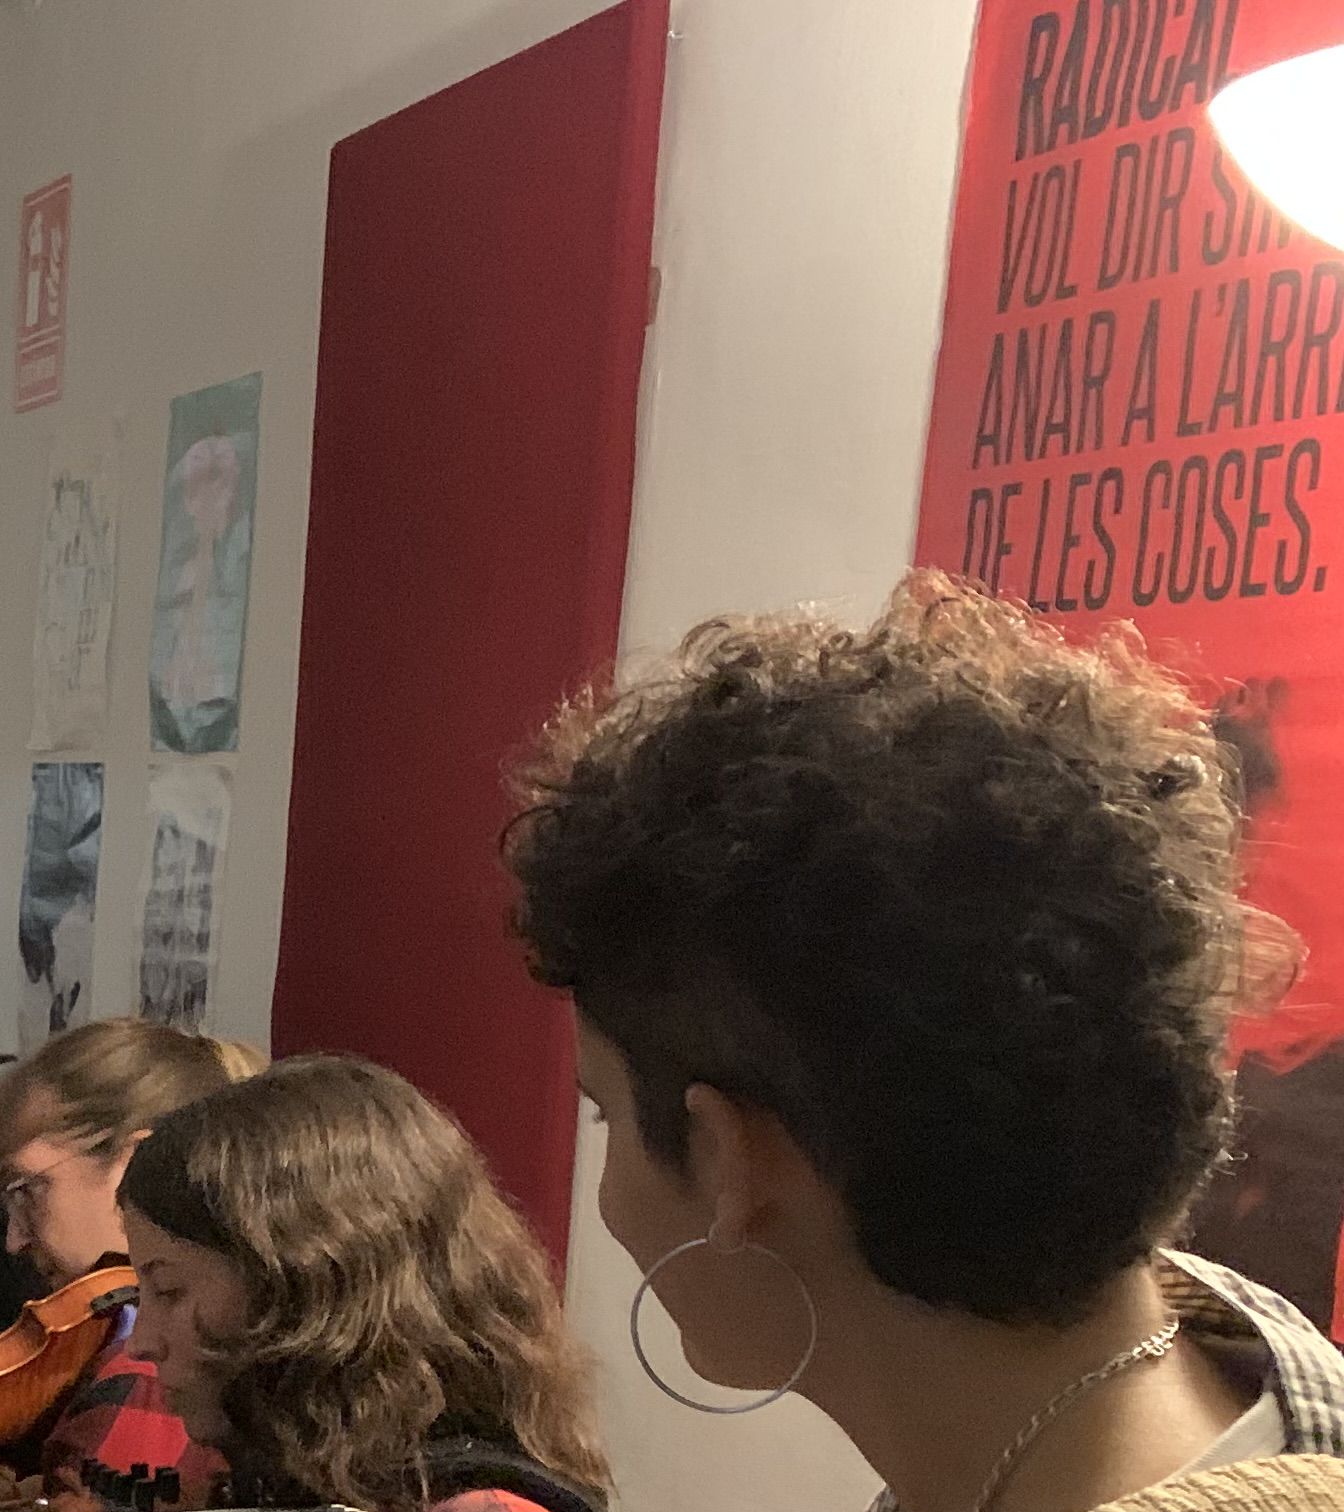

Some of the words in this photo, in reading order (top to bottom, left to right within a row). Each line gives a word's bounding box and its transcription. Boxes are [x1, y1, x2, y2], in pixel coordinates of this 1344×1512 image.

[1015, 0, 1242, 162] RADICAL
[997, 158, 1082, 315] VOL
[1097, 126, 1195, 291] DIR
[972, 310, 1115, 470] ANAR
[1121, 299, 1160, 447] A
[1177, 262, 1344, 437] L'ARR
[963, 482, 1023, 597] DE
[1029, 467, 1124, 613] LES
[1132, 438, 1326, 607] COSES.
